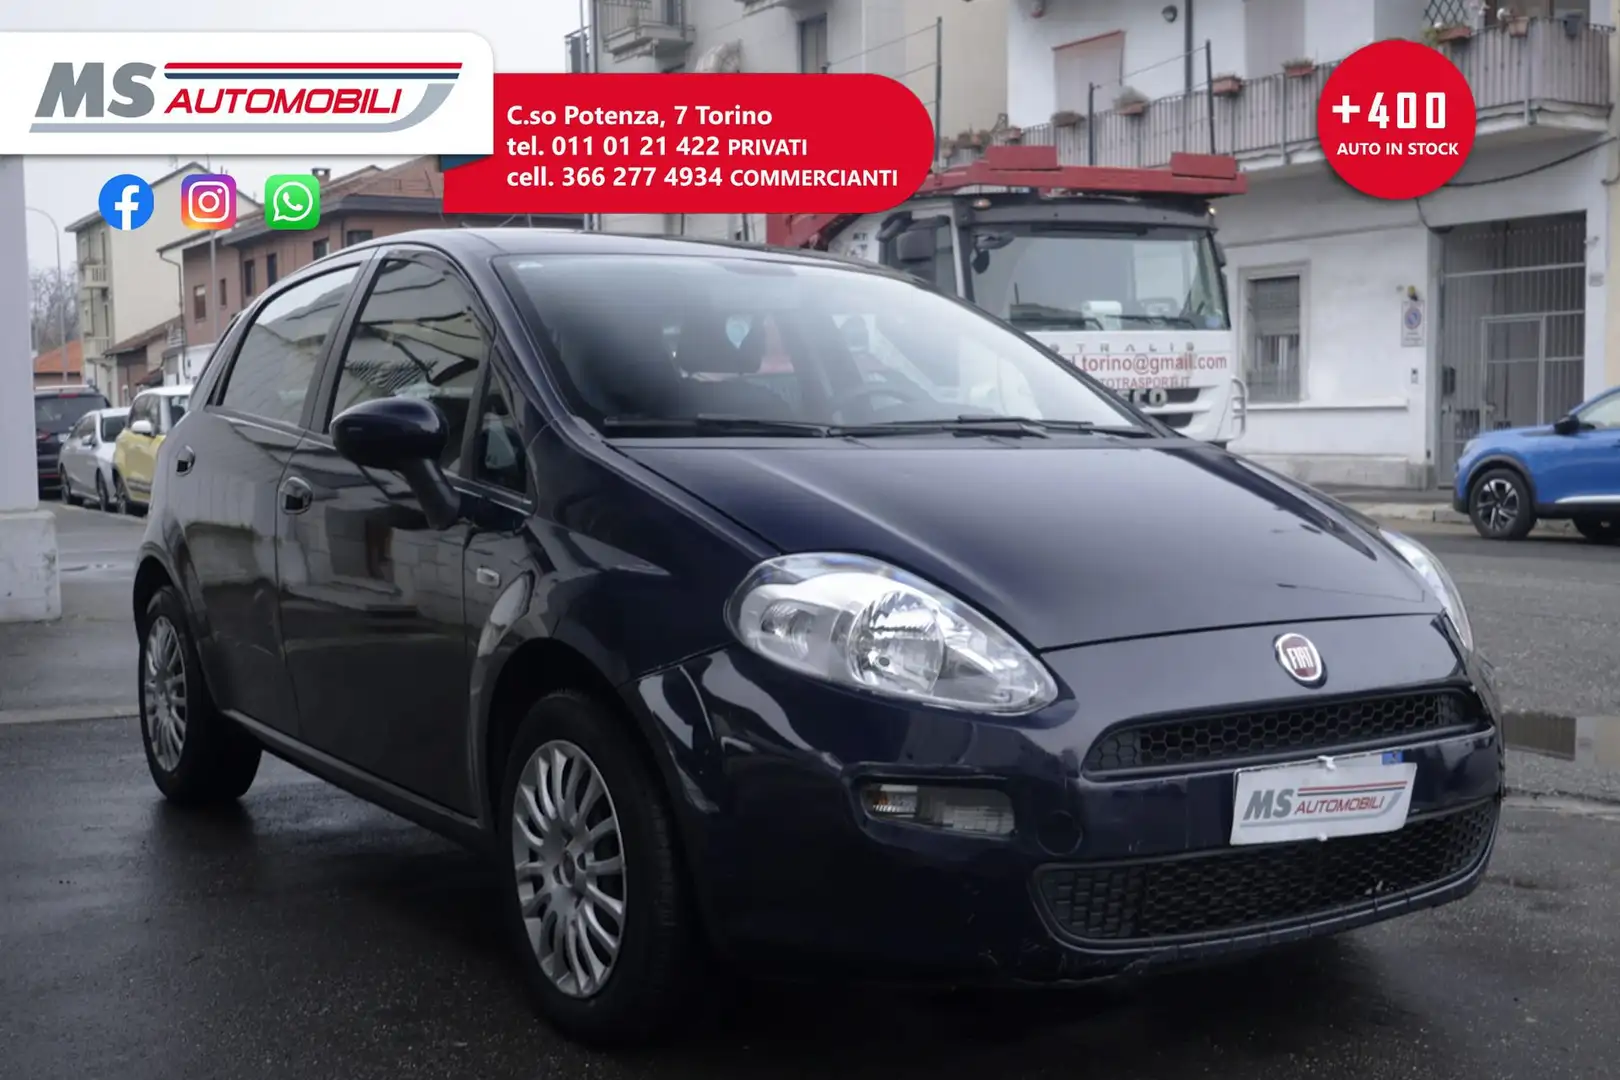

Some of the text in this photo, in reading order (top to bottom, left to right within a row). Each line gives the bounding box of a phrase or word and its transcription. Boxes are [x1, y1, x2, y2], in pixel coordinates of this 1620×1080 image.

[1286, 646, 1315, 670] FIAT
[1243, 788, 1385, 820] MS AUTOMOBILI
